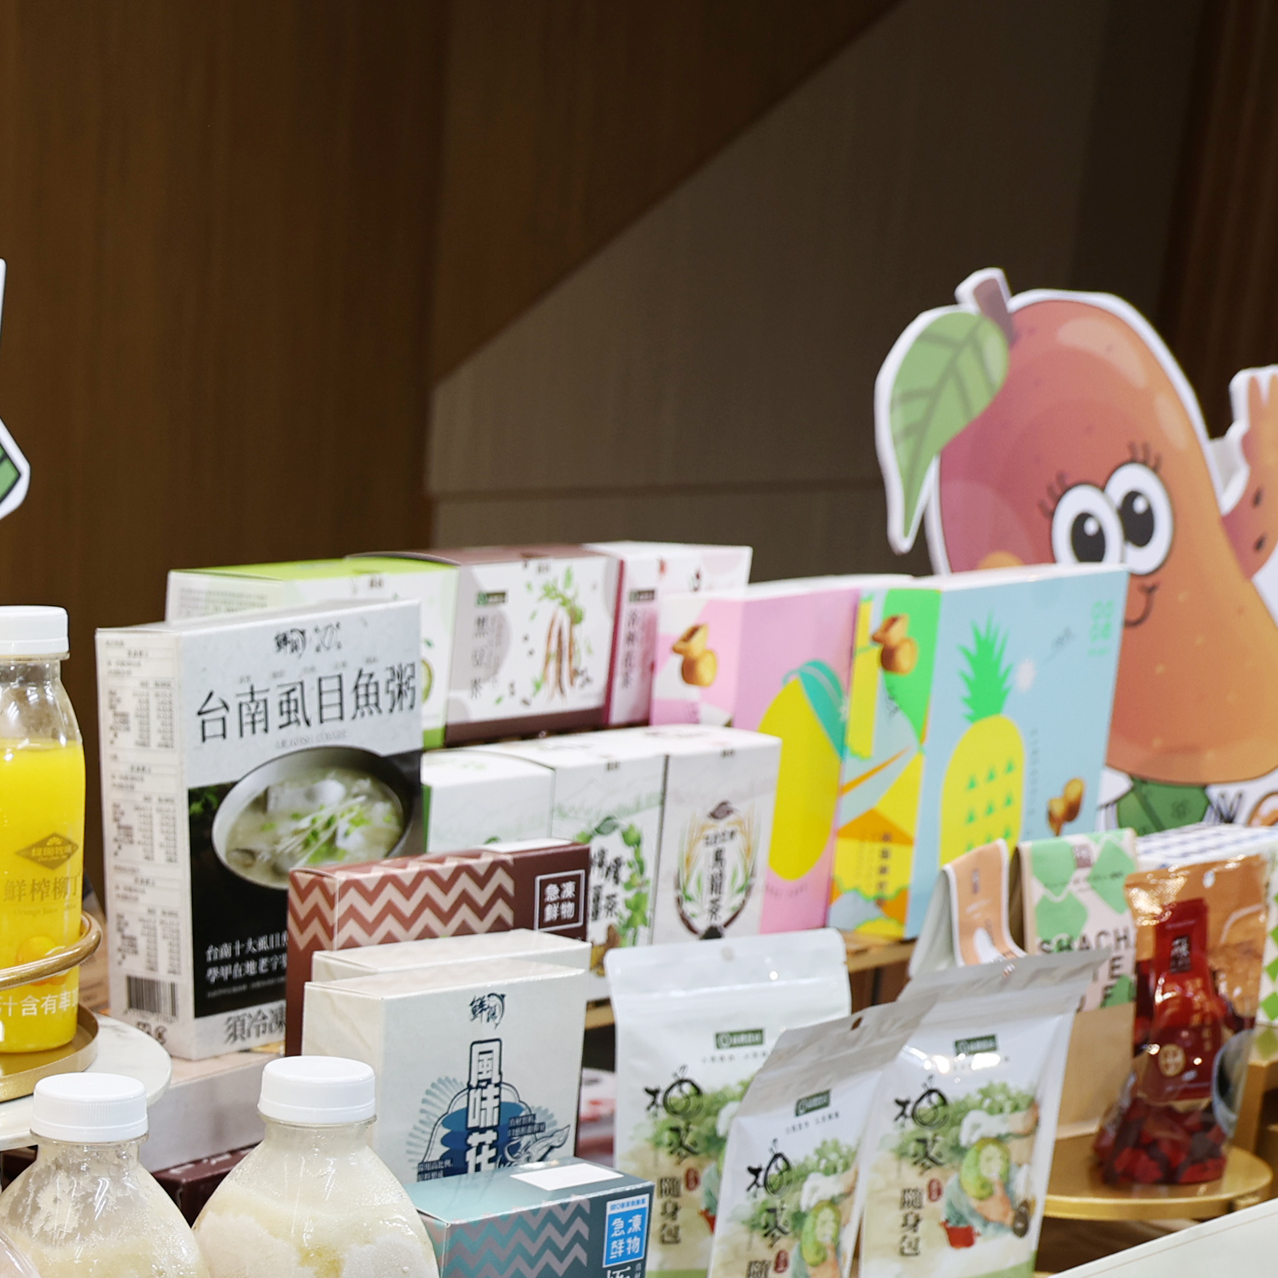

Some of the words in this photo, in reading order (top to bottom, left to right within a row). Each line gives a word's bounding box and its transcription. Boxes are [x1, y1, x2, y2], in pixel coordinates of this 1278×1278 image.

[197, 662, 416, 743] 台南虱目魚粥
[611, 1213, 643, 1237] 急凍
[609, 1236, 641, 1260] 鮮物
